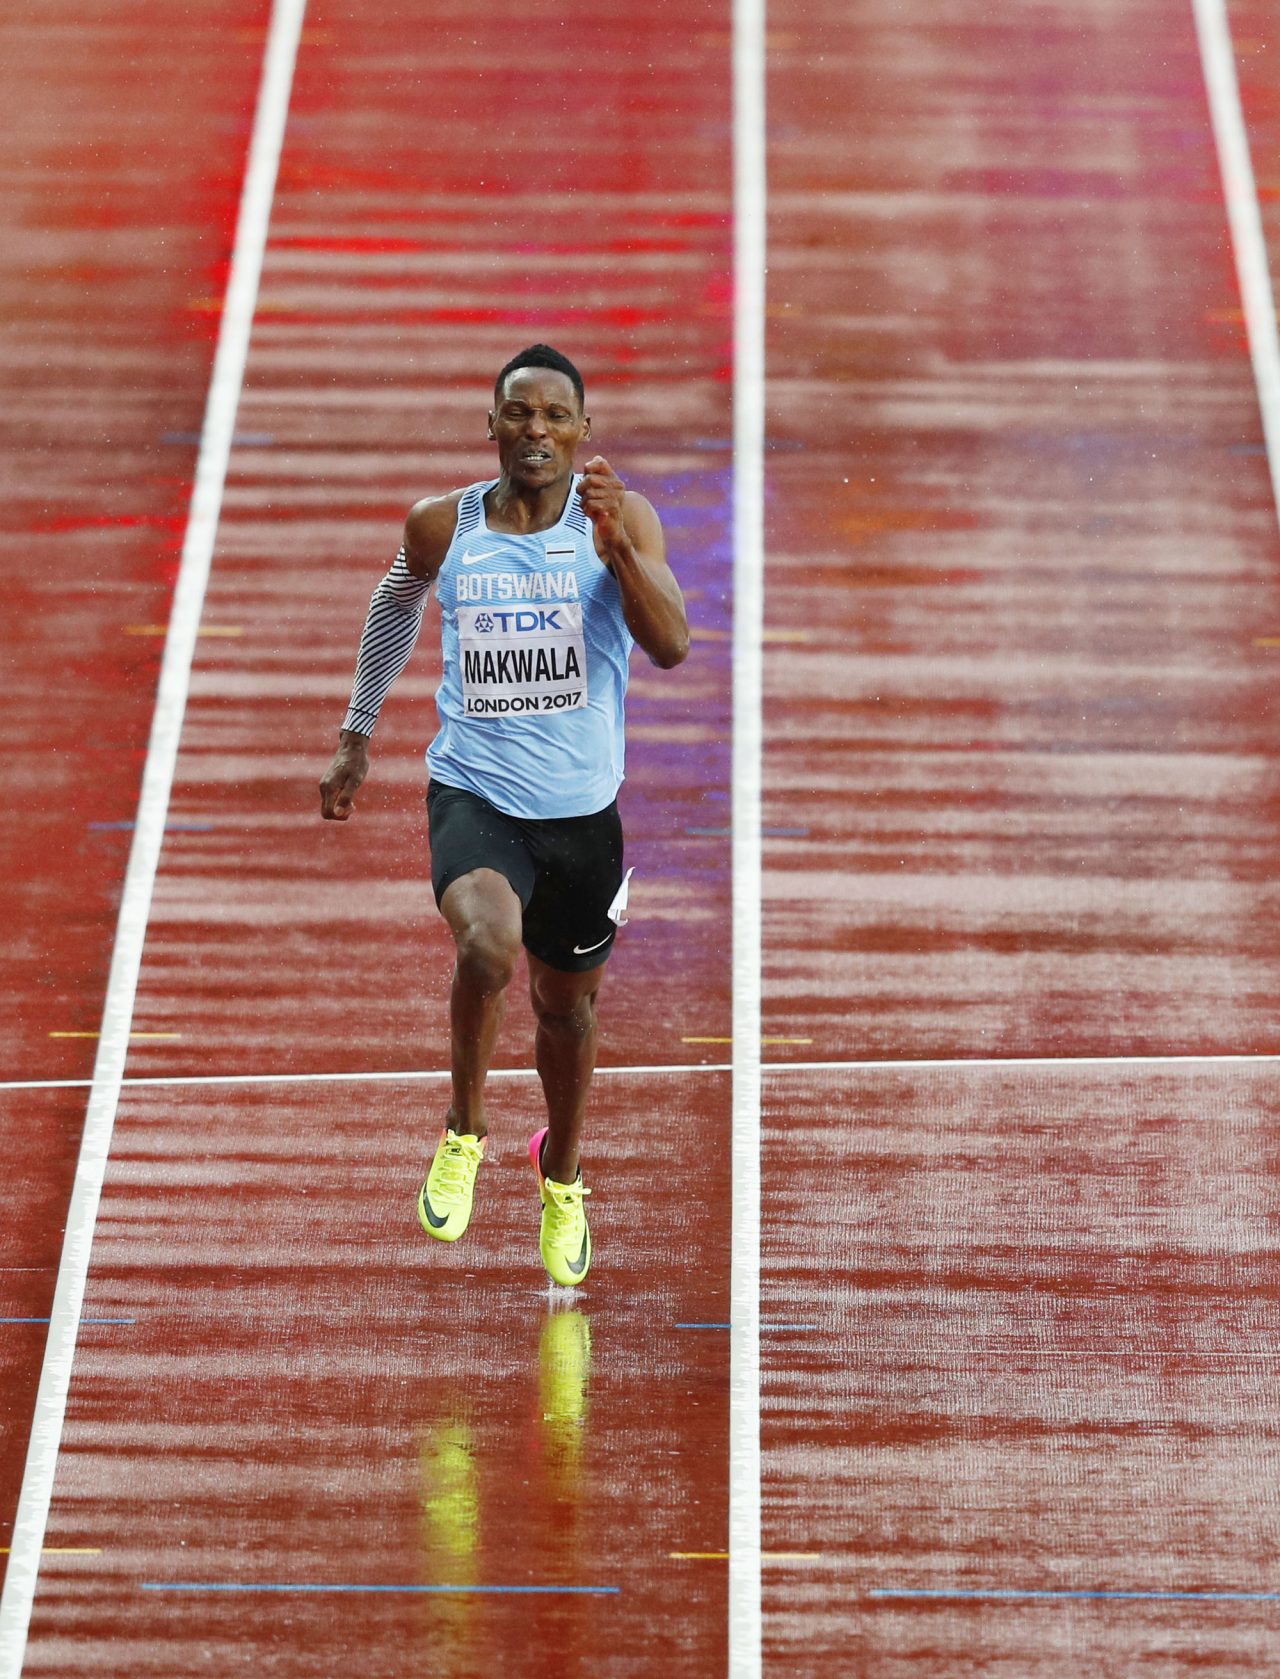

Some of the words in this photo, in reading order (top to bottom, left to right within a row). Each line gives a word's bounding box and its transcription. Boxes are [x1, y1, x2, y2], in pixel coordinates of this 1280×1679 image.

[456, 572, 579, 601] BOTSWANA
[493, 610, 562, 633] TDK
[464, 646, 581, 684] MAKWALA
[467, 696, 539, 713] LONDON
[542, 691, 582, 710] 2017
